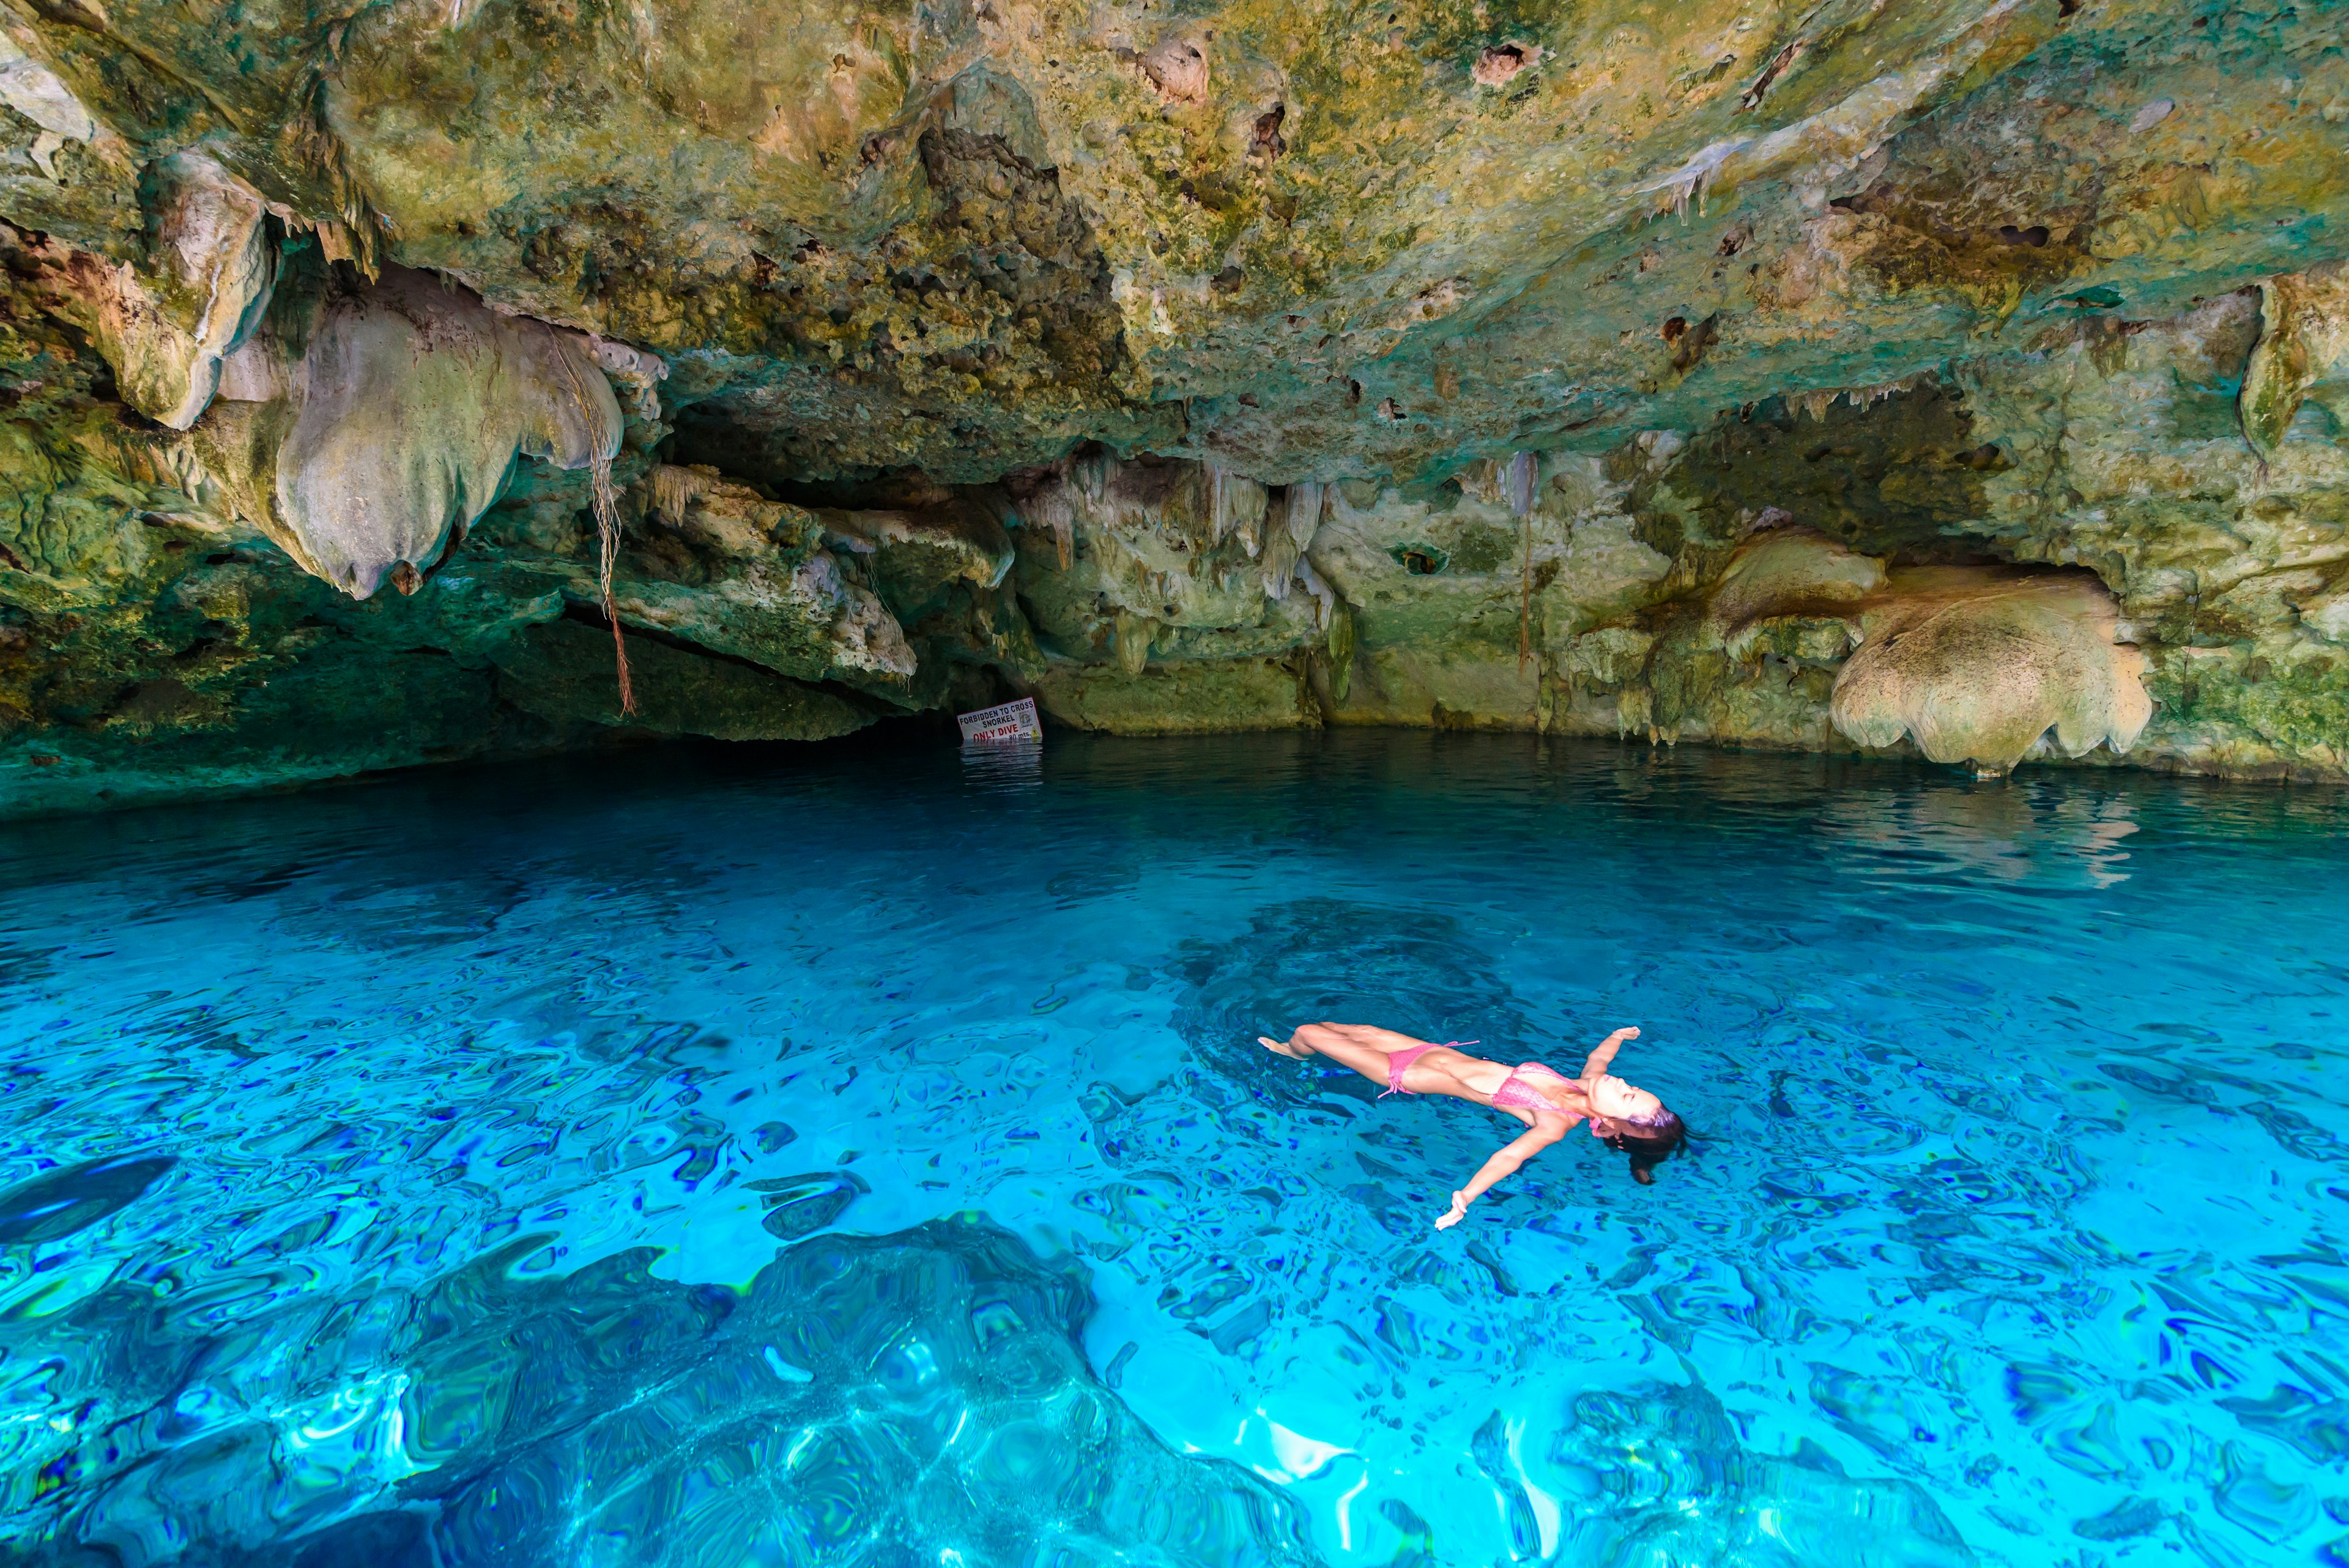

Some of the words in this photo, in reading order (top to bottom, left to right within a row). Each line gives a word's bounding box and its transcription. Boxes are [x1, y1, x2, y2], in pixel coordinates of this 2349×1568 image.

[960, 710, 998, 725] FORBIDDEN
[1011, 701, 1033, 712] CROSS
[982, 715, 1015, 728] SNORKEL
[973, 730, 995, 741] ONLY
[998, 724, 1019, 736] DIVE
